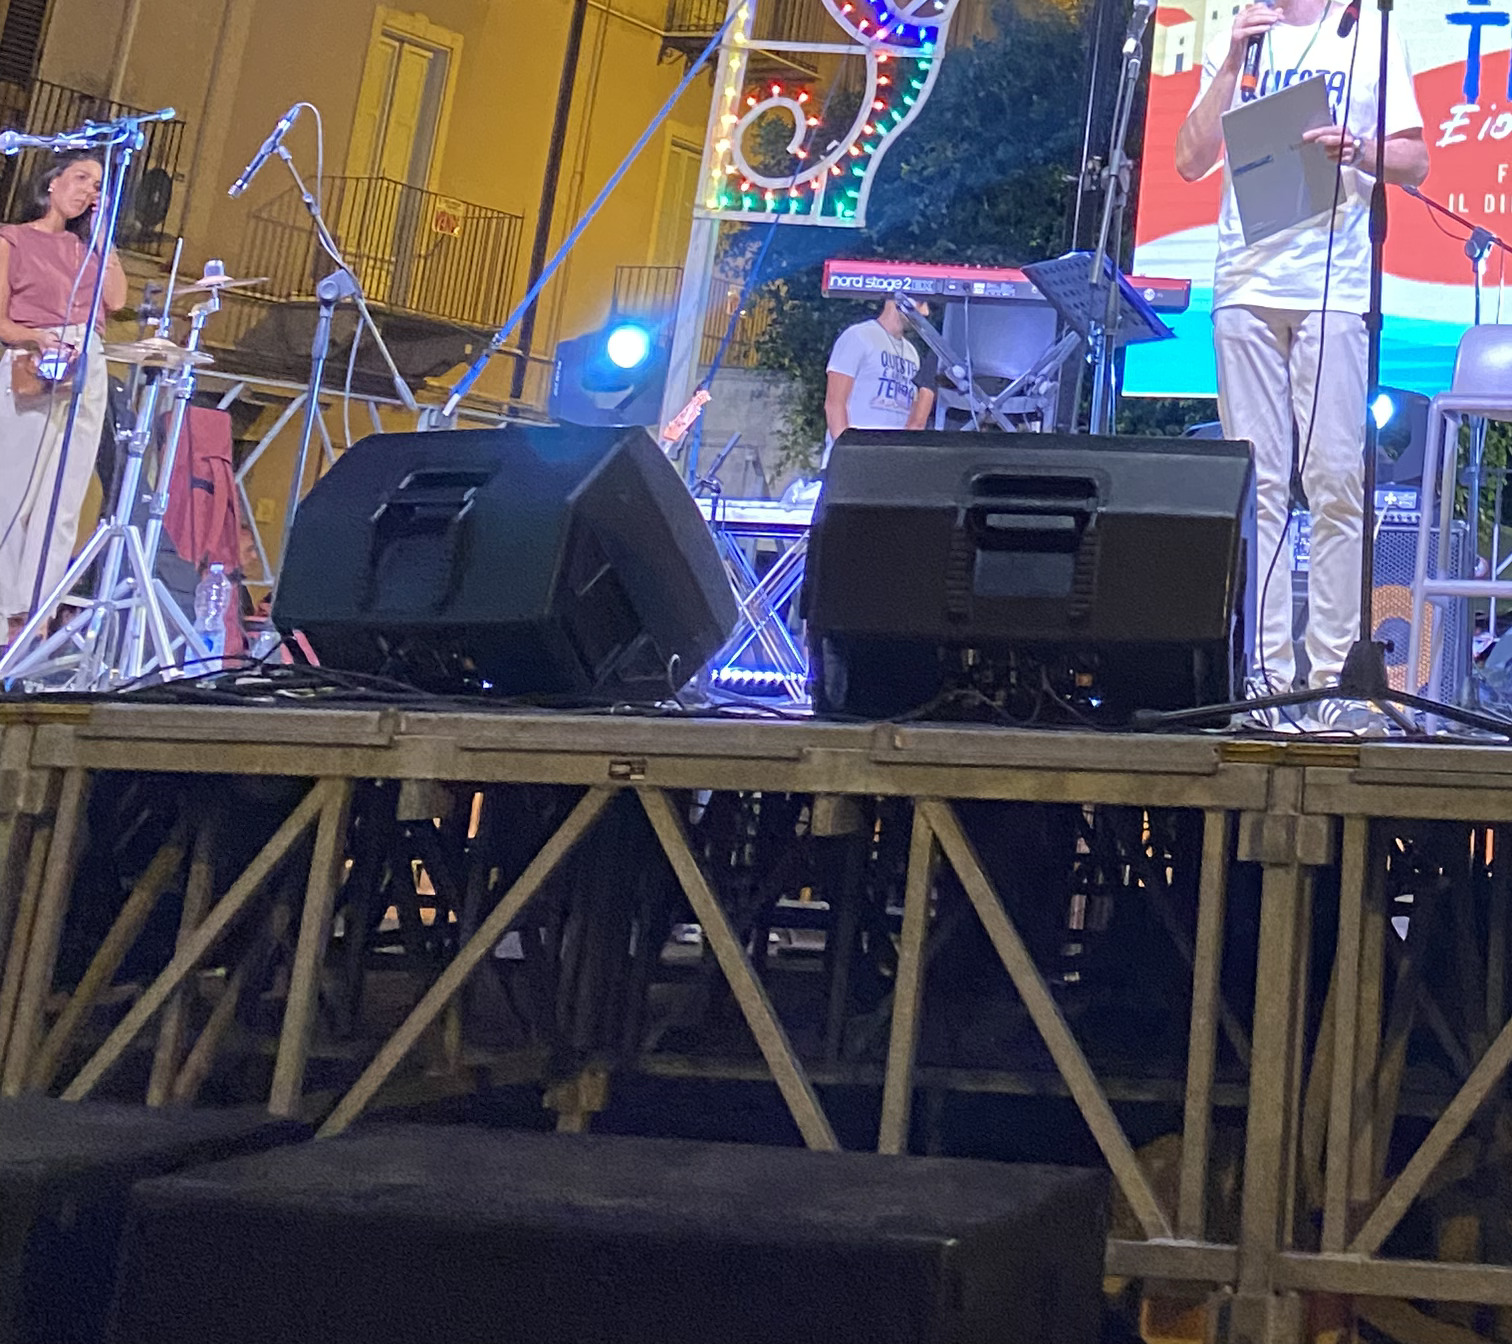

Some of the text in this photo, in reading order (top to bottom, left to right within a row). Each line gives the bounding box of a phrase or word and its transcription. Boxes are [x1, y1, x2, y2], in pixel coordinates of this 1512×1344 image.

[1435, 104, 1480, 147] E
[1448, 193, 1469, 213] IL
[830, 275, 863, 288] nord
